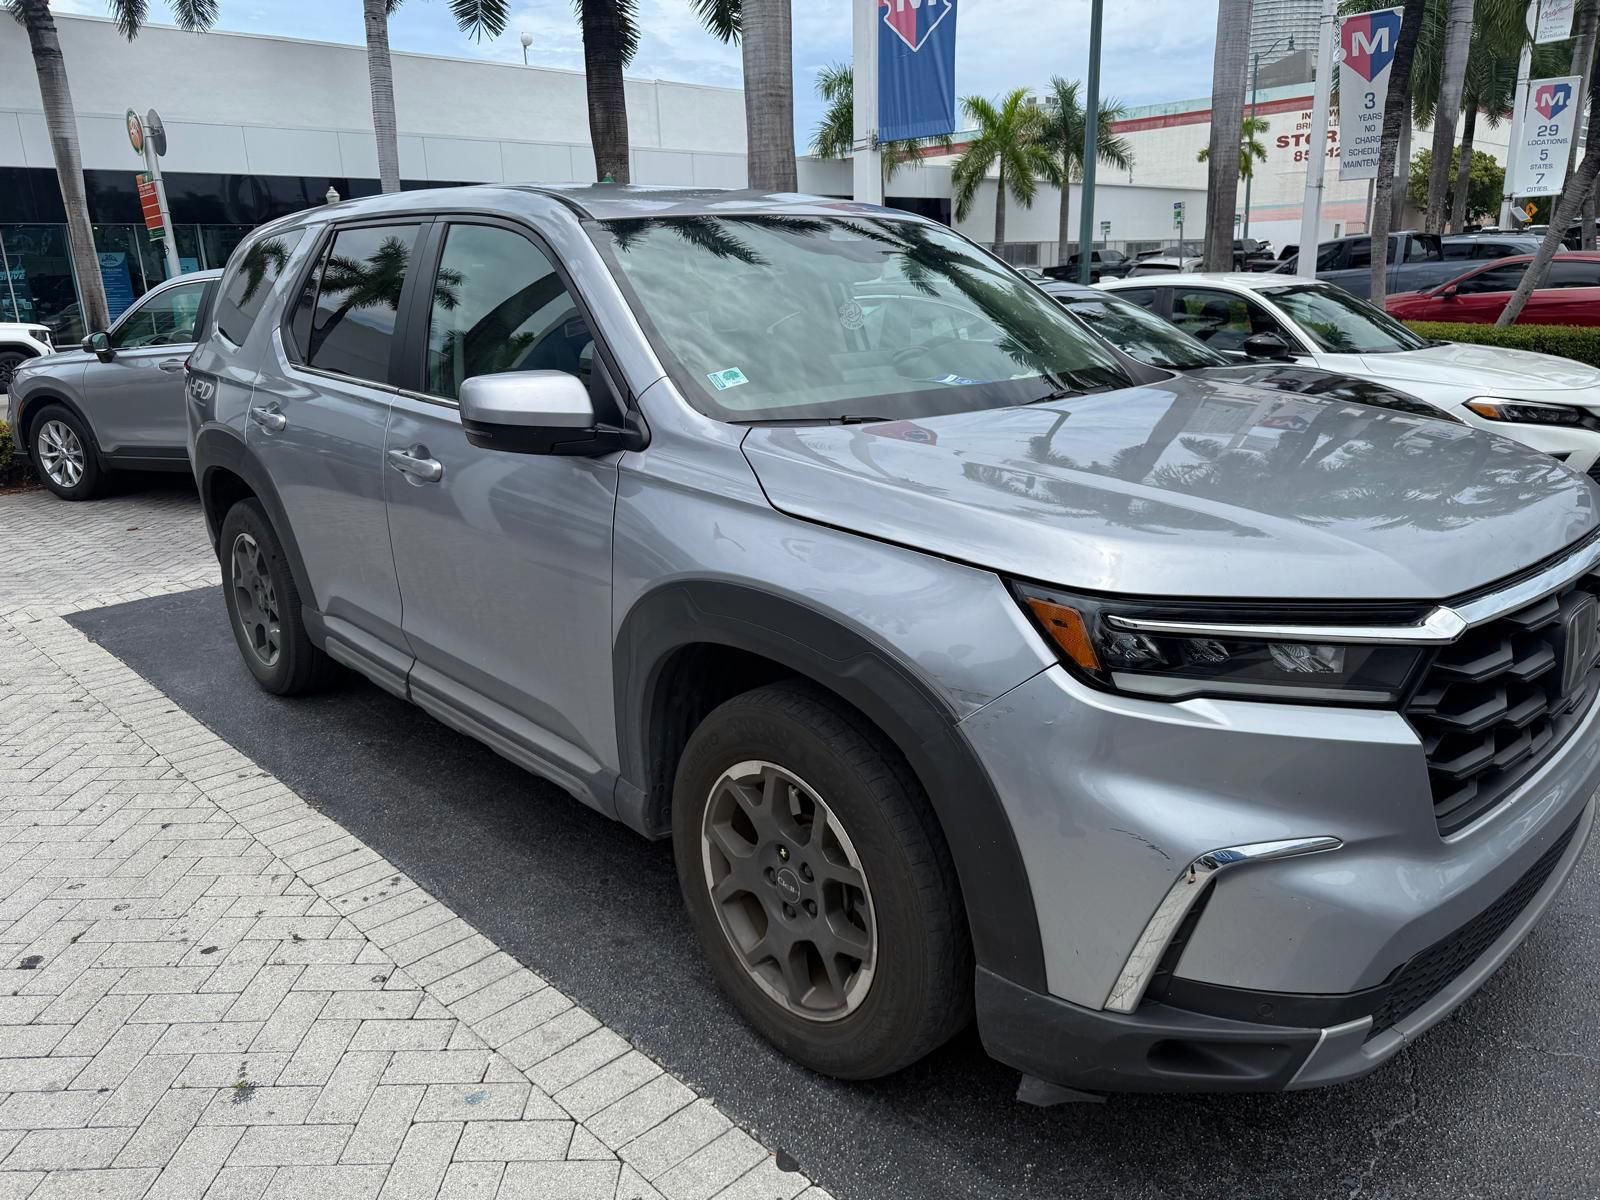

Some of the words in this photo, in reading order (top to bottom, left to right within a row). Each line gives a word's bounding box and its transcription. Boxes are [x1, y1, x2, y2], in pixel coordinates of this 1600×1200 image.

[1352, 27, 1389, 57] M
[1364, 92, 1376, 110] 3
[1540, 91, 1565, 107] M
[1358, 113, 1383, 122] YEARS
[1364, 125, 1376, 133] NO
[1537, 124, 1559, 137] 29
[1355, 135, 1381, 144] CHARG
[1348, 147, 1381, 157] SCHEDUL
[1539, 149, 1549, 161] 5
[1535, 173, 1545, 185] 7
